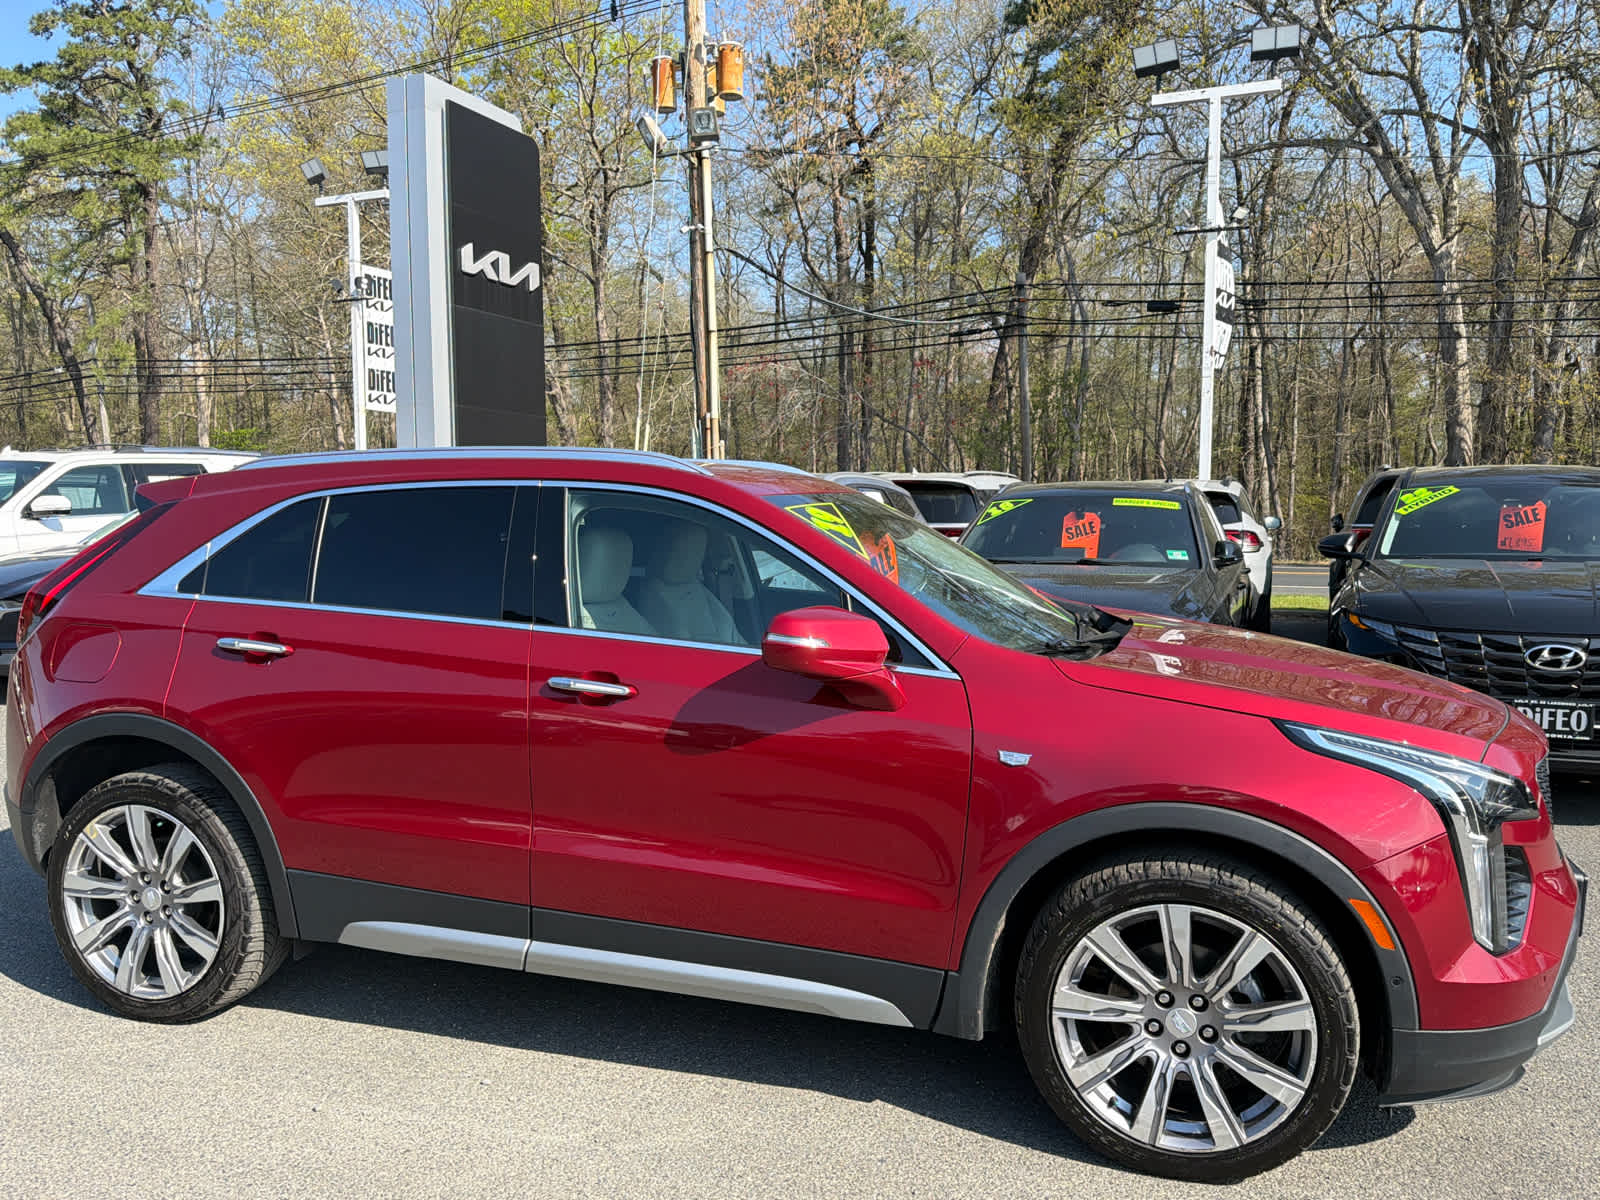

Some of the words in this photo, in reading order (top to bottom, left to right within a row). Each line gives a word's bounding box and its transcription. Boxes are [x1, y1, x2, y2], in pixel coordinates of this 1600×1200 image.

[461, 243, 540, 291] KIA
[1065, 521, 1097, 541] SALE
[1503, 507, 1542, 529] SALE
[870, 547, 896, 577] ALE
